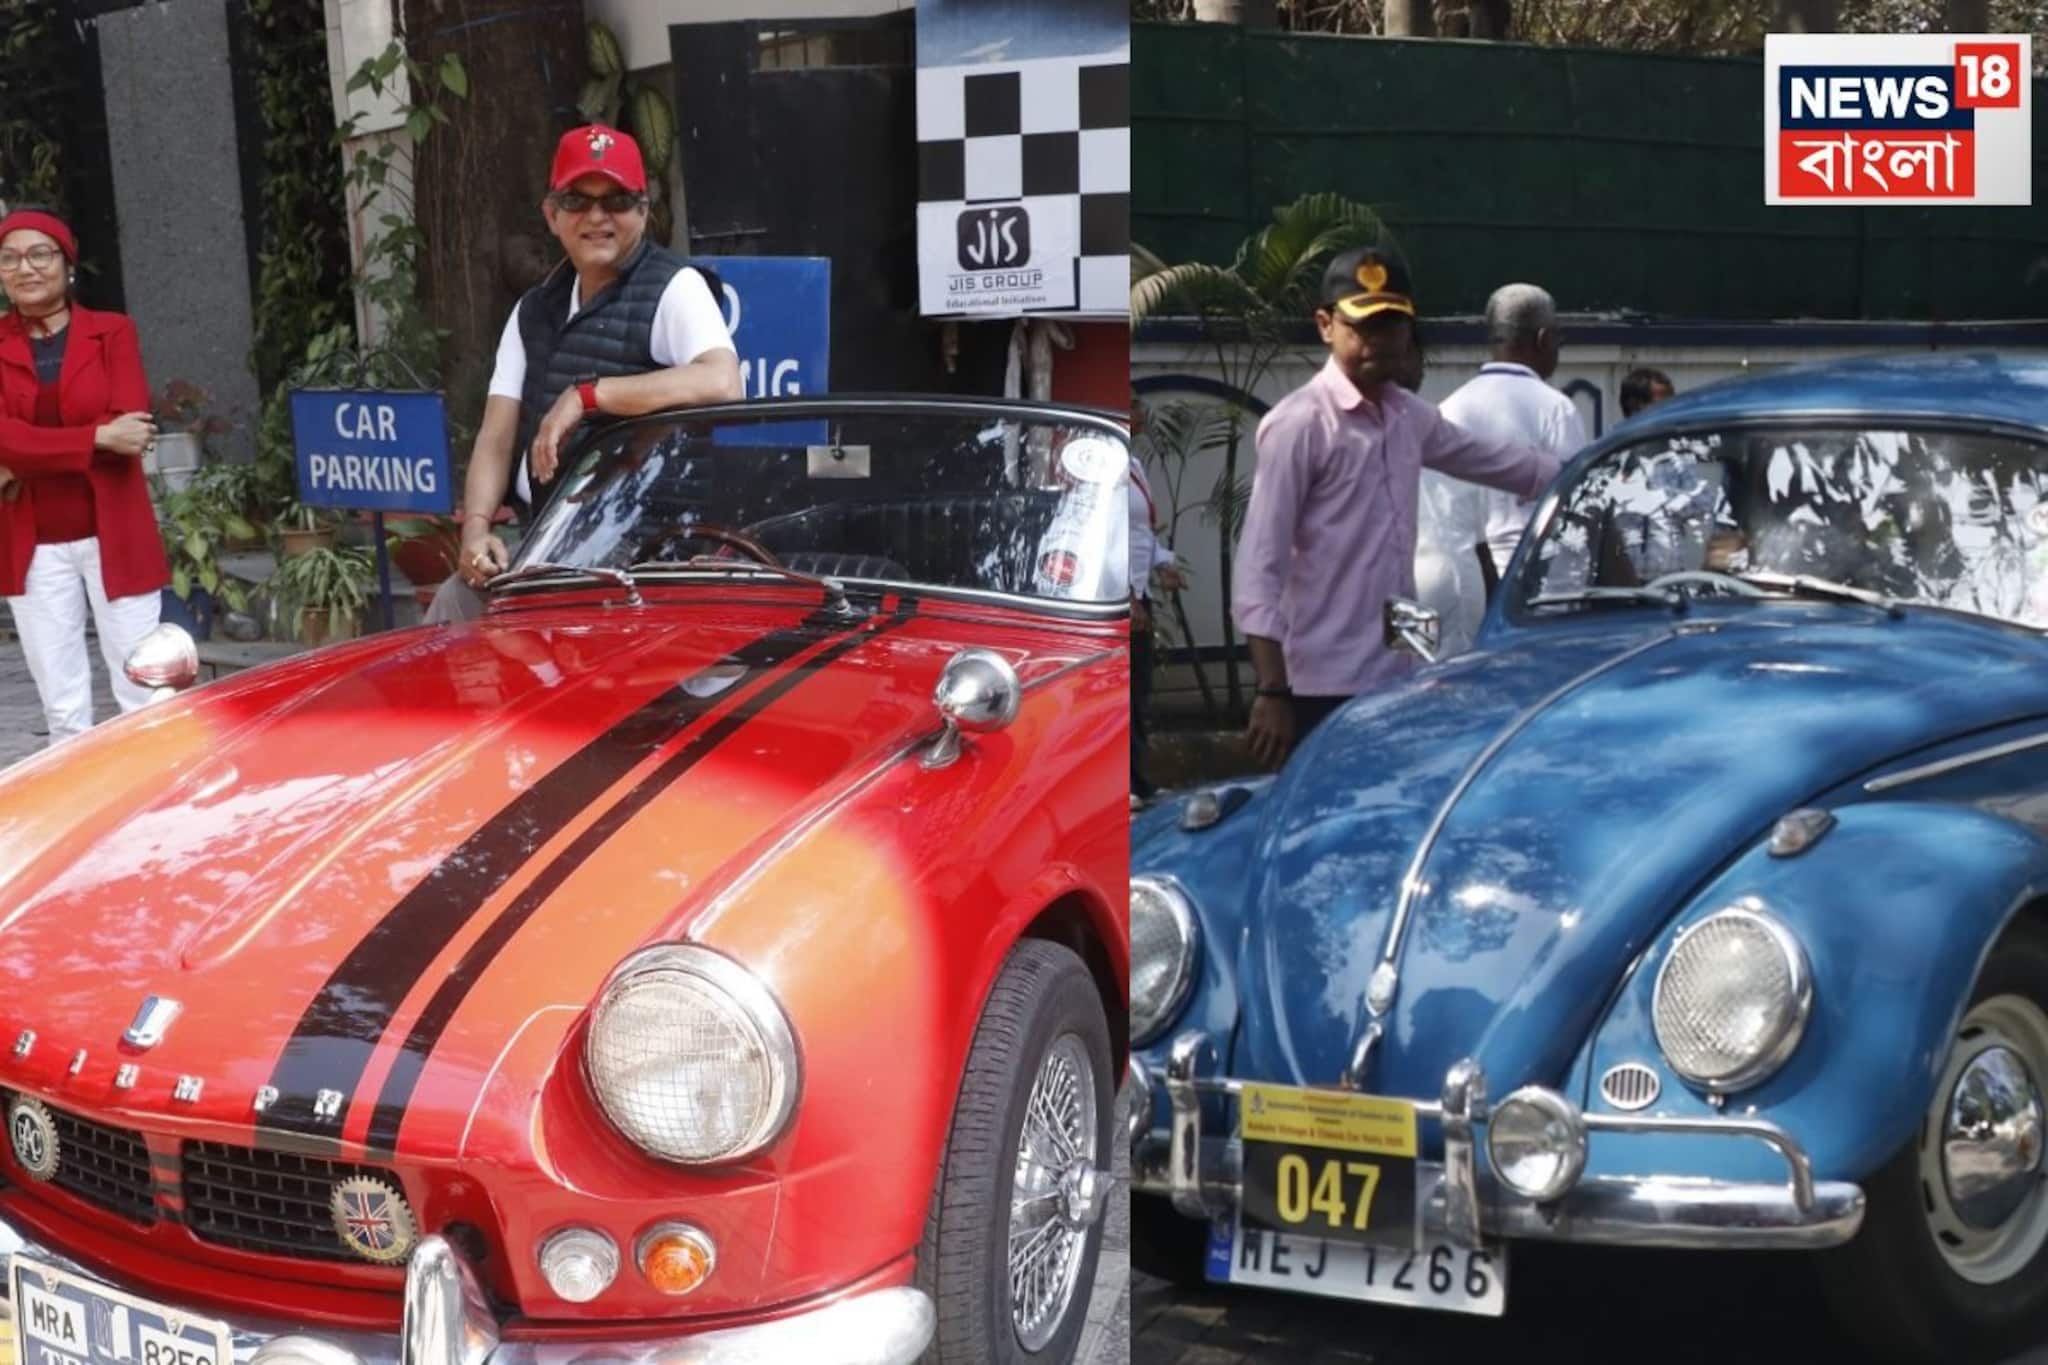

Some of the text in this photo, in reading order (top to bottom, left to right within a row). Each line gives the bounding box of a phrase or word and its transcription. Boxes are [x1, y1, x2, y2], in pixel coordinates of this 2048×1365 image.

[949, 272, 1044, 292] JIS GROUP
[334, 402, 398, 442] CAR
[309, 453, 437, 494] PARKING
[1276, 1153, 1382, 1231] 047
[1365, 1244, 1493, 1299] 1266
[31, 1296, 77, 1343] MRA
